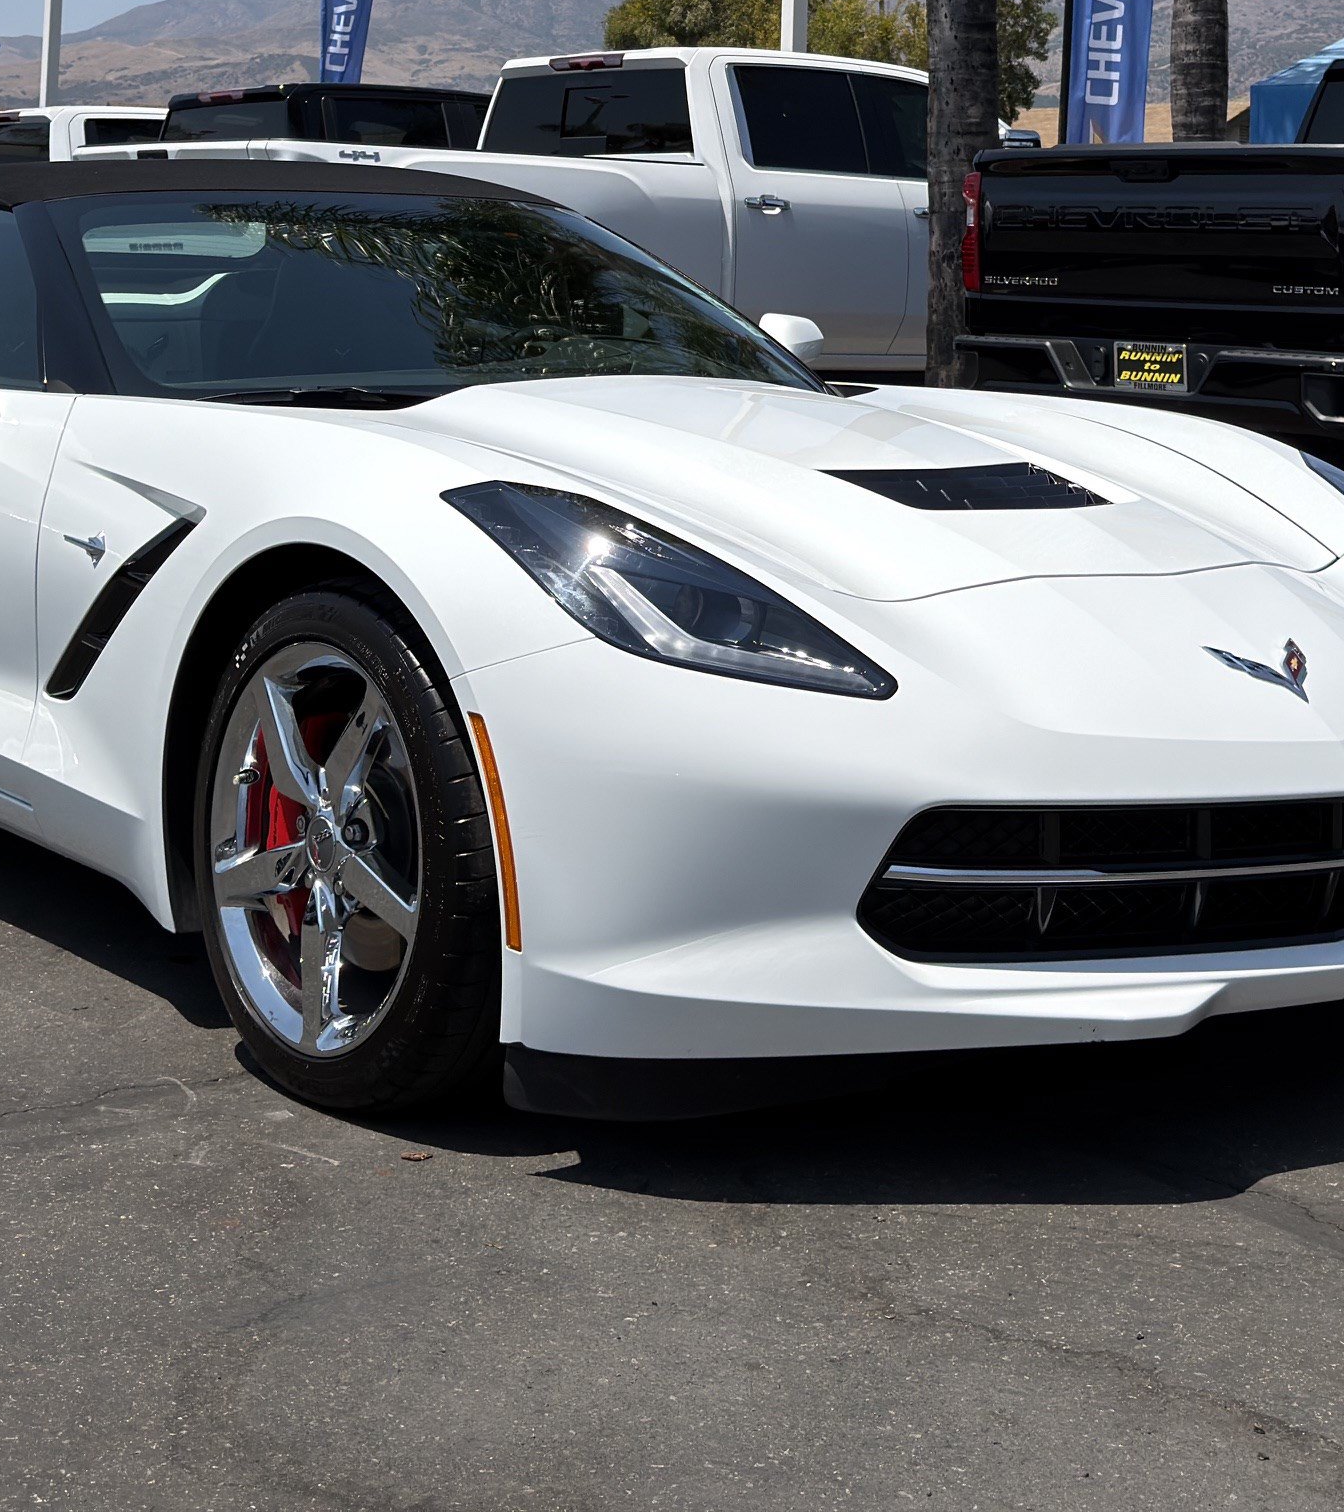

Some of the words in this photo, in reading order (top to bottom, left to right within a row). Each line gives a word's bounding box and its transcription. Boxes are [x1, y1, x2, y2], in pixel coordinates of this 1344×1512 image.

[996, 204, 1315, 231] CHEVROLET
[983, 275, 1059, 288] SILVERADO
[1271, 284, 1340, 297] CUSTOM
[1131, 343, 1167, 353] BUNNIN
[1143, 362, 1161, 370] to
[1120, 370, 1181, 383] BUNNIN
[1133, 381, 1167, 391] FILLMORE
